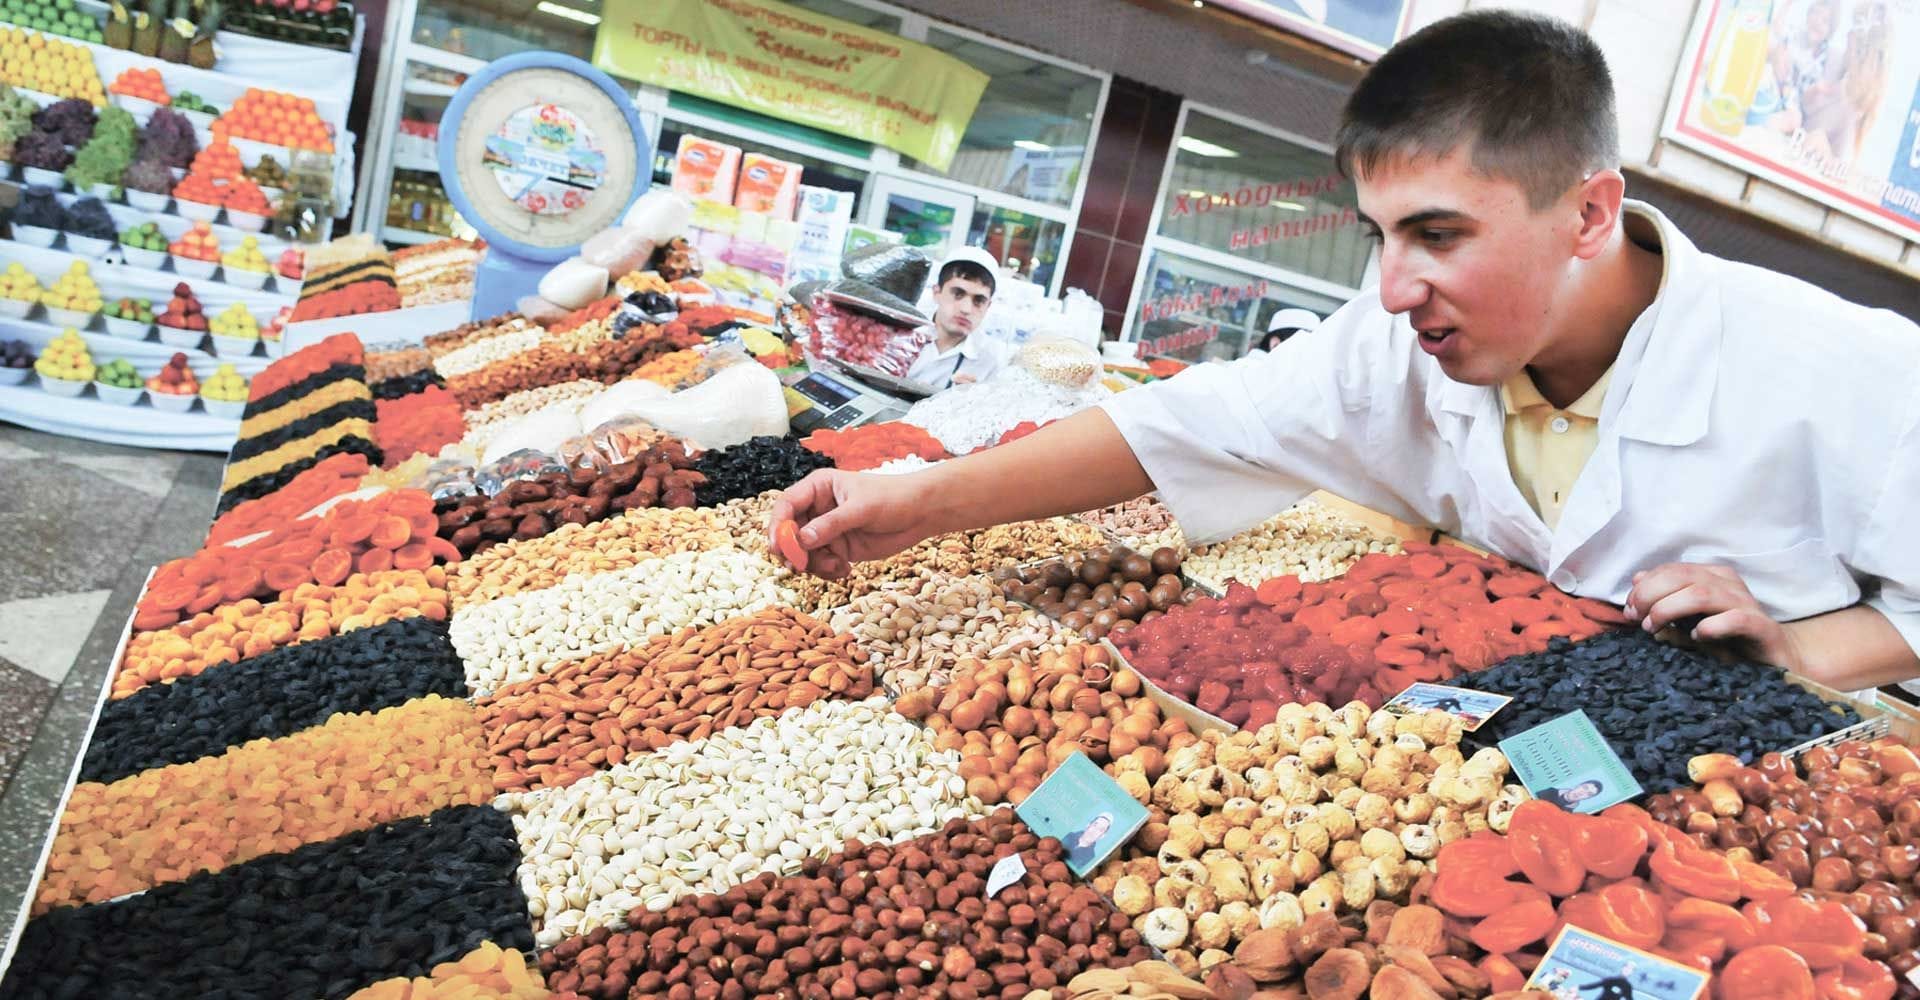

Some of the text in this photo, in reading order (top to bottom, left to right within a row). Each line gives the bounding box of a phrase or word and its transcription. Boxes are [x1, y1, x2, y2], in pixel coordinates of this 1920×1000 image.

[633, 23, 701, 55] ТОРТЫ
[705, 48, 728, 64] на
[1171, 174, 1345, 217] Холодные
